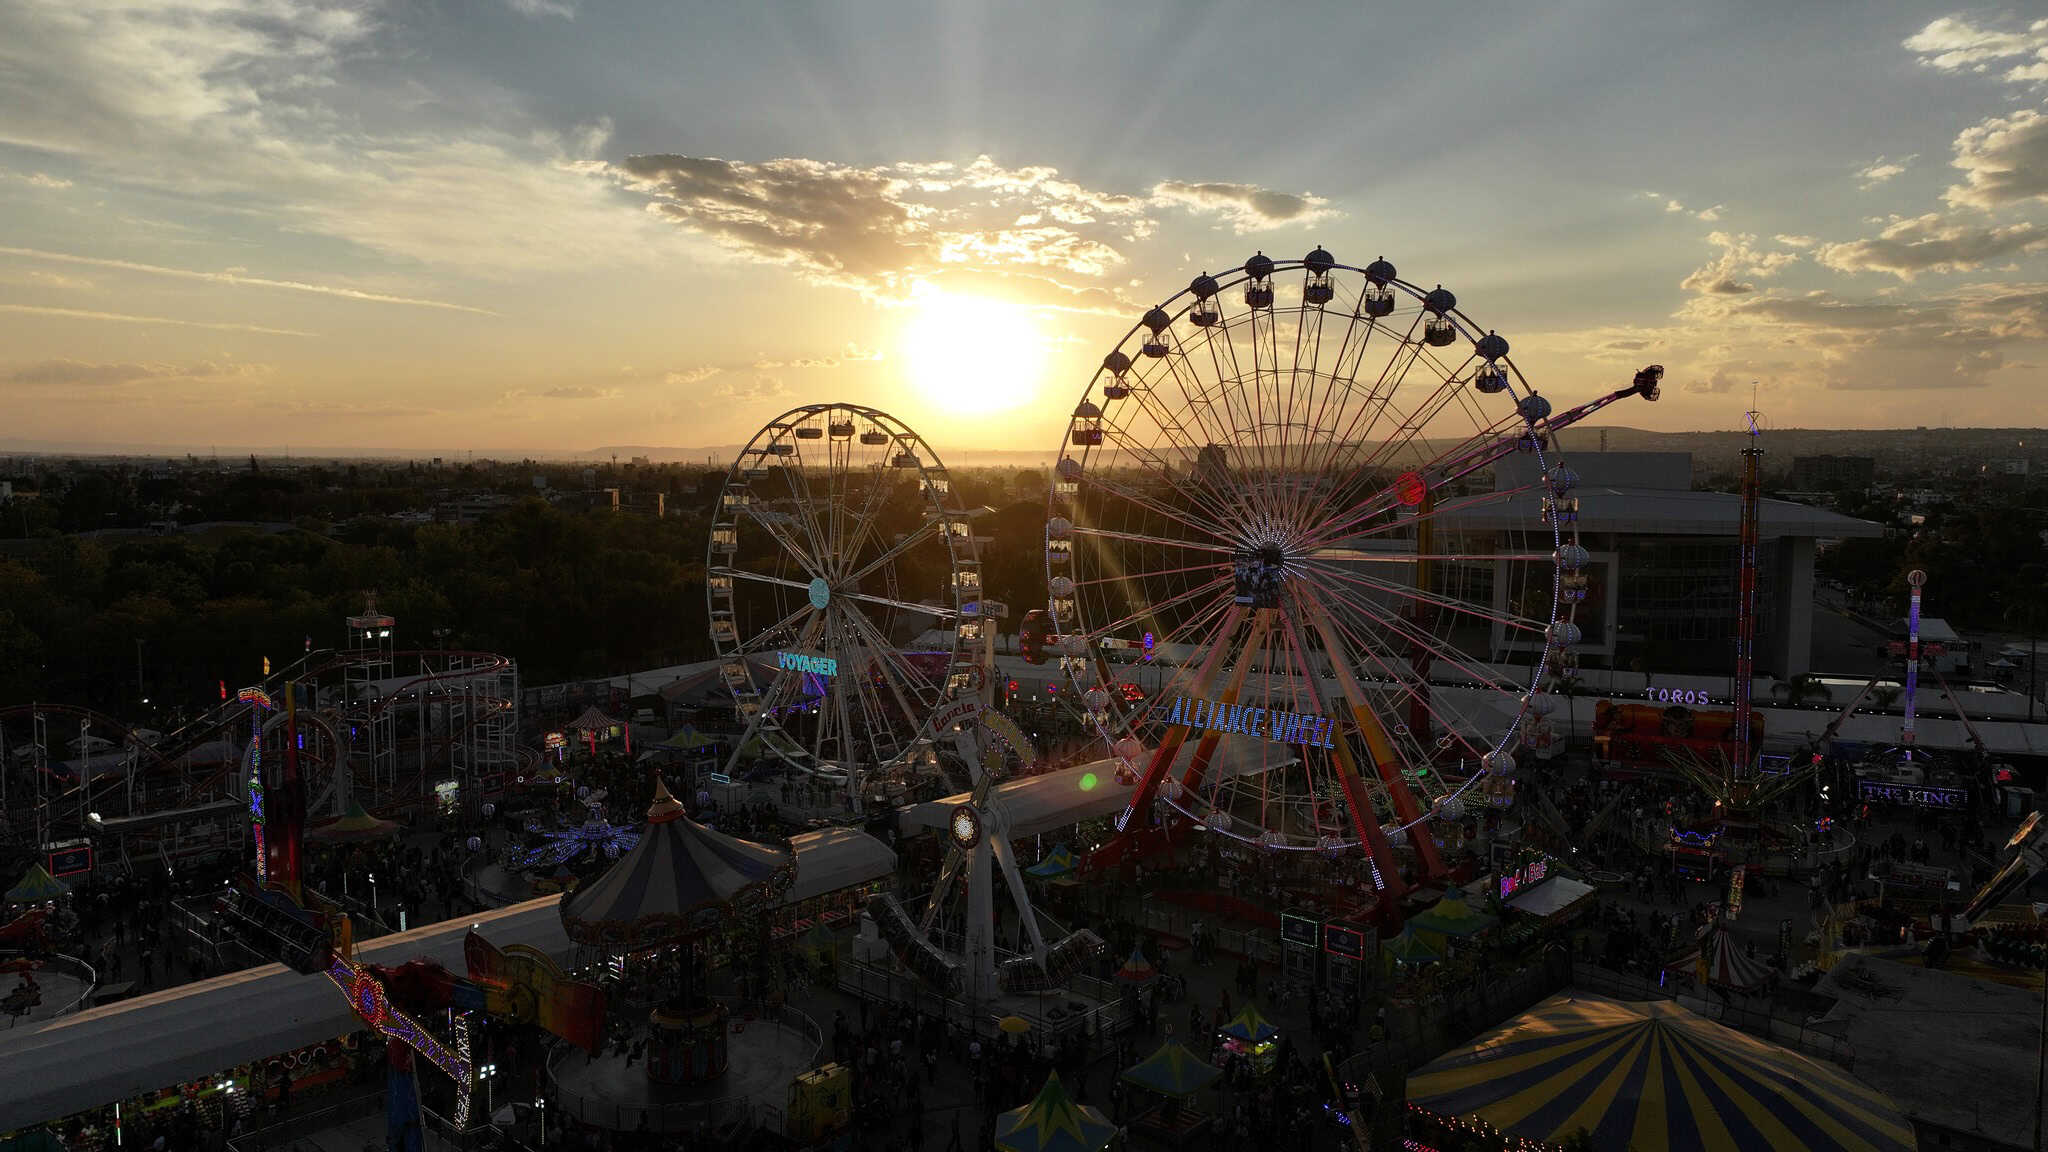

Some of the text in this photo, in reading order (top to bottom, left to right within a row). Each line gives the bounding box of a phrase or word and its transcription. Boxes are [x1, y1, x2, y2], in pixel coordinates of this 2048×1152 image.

[777, 651, 838, 677] VOYAGER
[1646, 687, 1709, 705] TOROS
[1170, 696, 1336, 750] ALLIANCE WHEEL
[1863, 785, 1959, 807] THE KING
